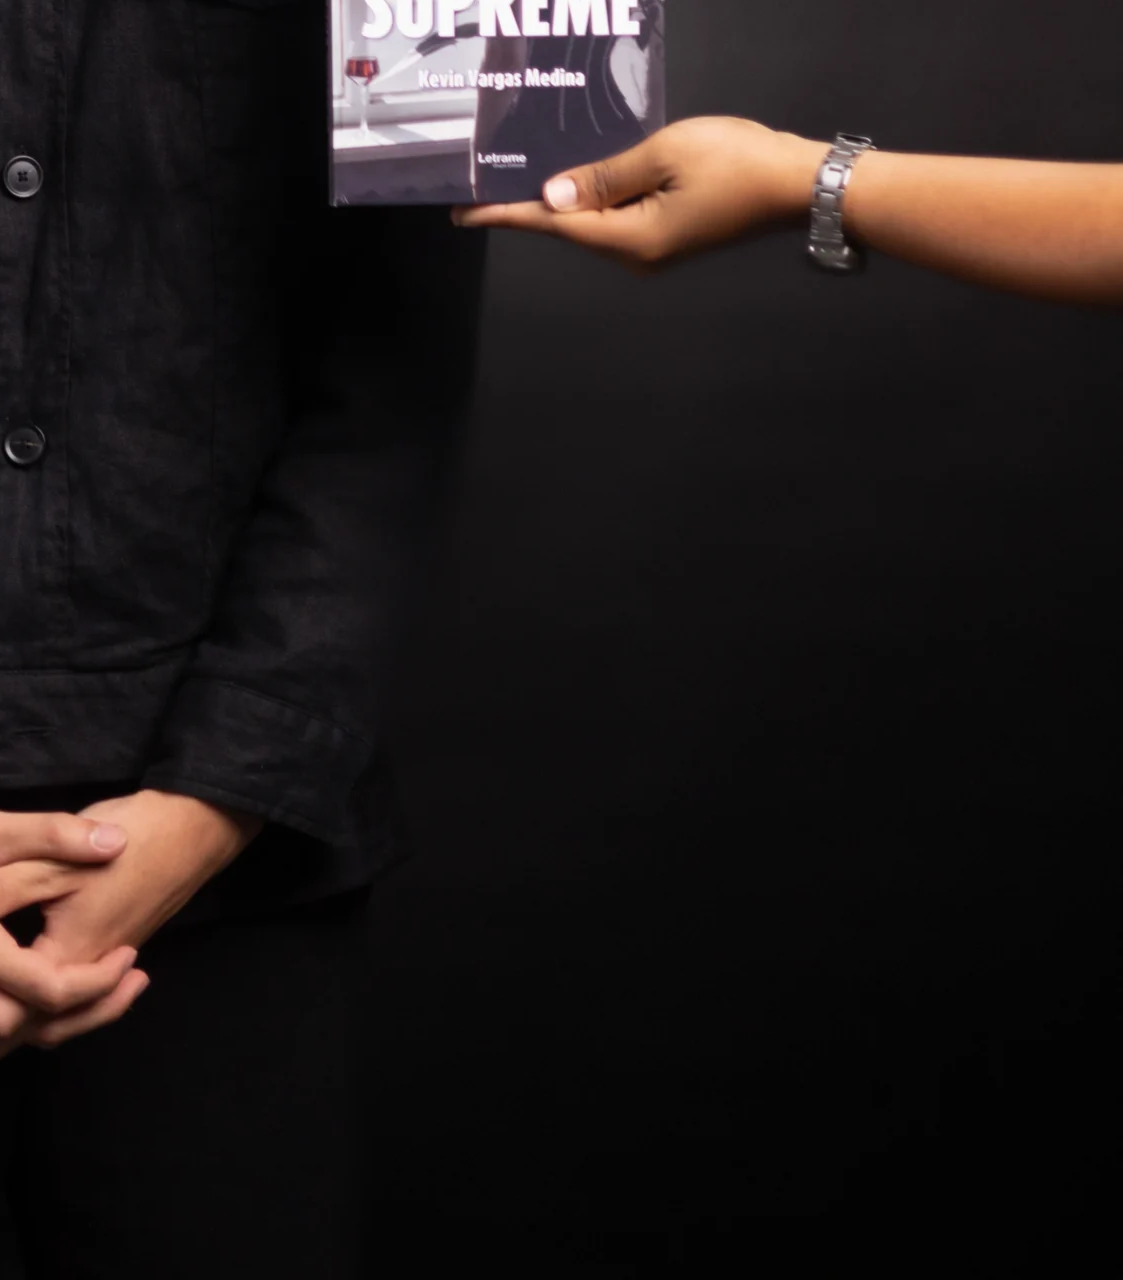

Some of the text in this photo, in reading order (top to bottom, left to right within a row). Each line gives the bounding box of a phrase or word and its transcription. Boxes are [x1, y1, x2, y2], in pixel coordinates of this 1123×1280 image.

[418, 68, 586, 91] Kevin Vargas Medina
[477, 152, 527, 164] Letrame
